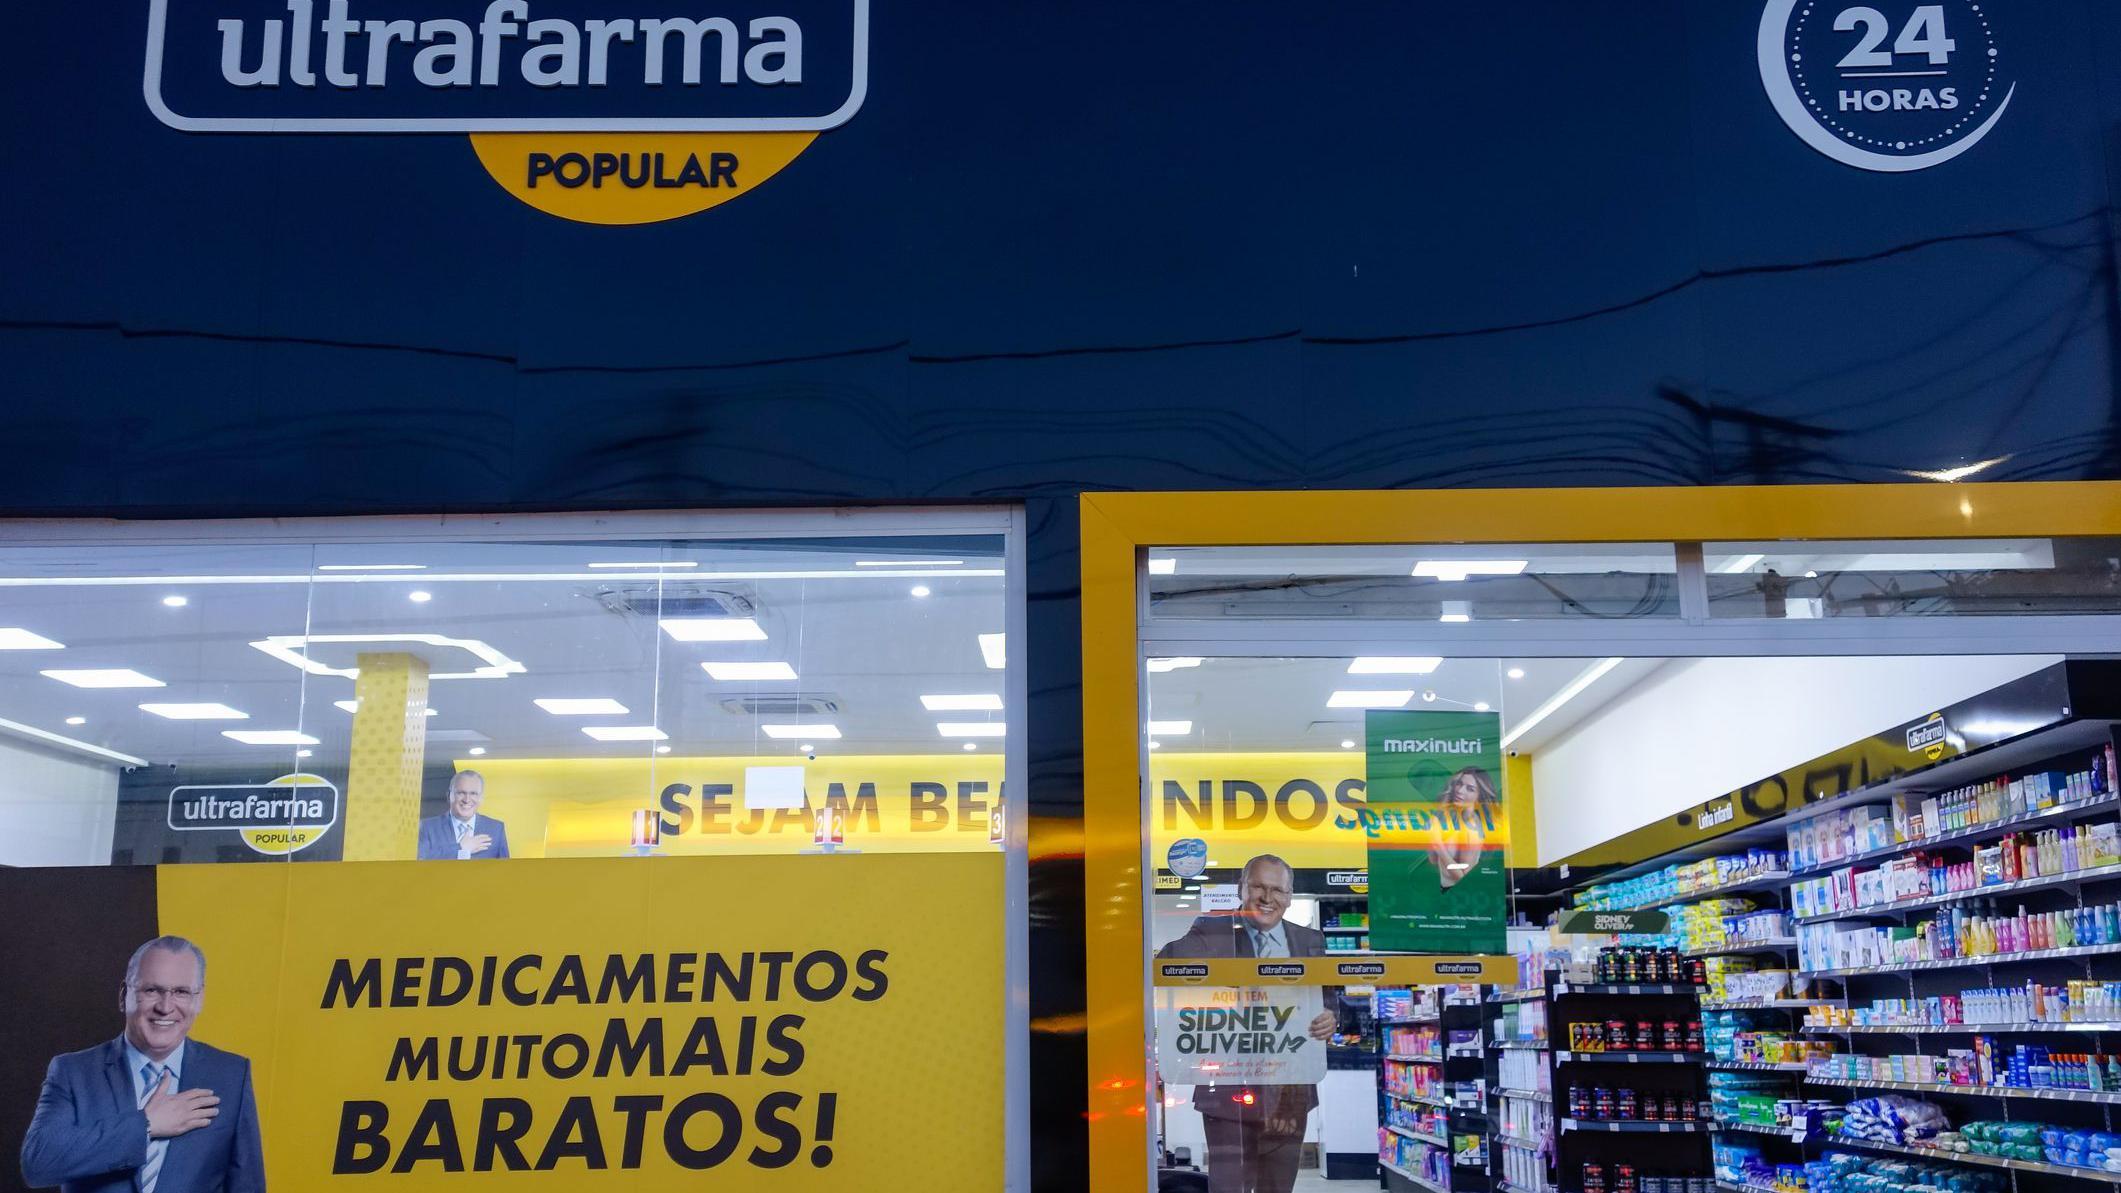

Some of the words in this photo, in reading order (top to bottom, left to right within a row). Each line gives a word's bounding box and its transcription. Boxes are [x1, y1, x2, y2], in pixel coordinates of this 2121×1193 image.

[217, 0, 804, 88] ultrafarma
[1833, 5, 1956, 67] 24
[1838, 87, 1959, 112] HORAS
[527, 152, 738, 189] POPULAR
[183, 795, 323, 820] ultrafarma
[910, 781, 1005, 832] BE
[1150, 778, 1368, 832] NDOS
[832, 814, 843, 837] 2
[992, 812, 1002, 835] 3
[255, 833, 306, 845] POPULAR
[1158, 876, 1180, 884] IMED
[1330, 874, 1368, 883] ultrafarm
[1594, 914, 1632, 923] SIDNEY
[320, 950, 889, 1009] MEDICAMENTOS
[1164, 965, 1206, 976] ultrafarma
[1260, 964, 1302, 975] ultrafarma
[1341, 964, 1383, 974] ultrafarma
[1437, 963, 1480, 973] ultrafarma
[1212, 991, 1241, 1003] AQUI
[1244, 991, 1268, 1002] TEM
[1178, 1005, 1296, 1032] SIDNEY
[332, 1092, 838, 1175] BARATOS!
